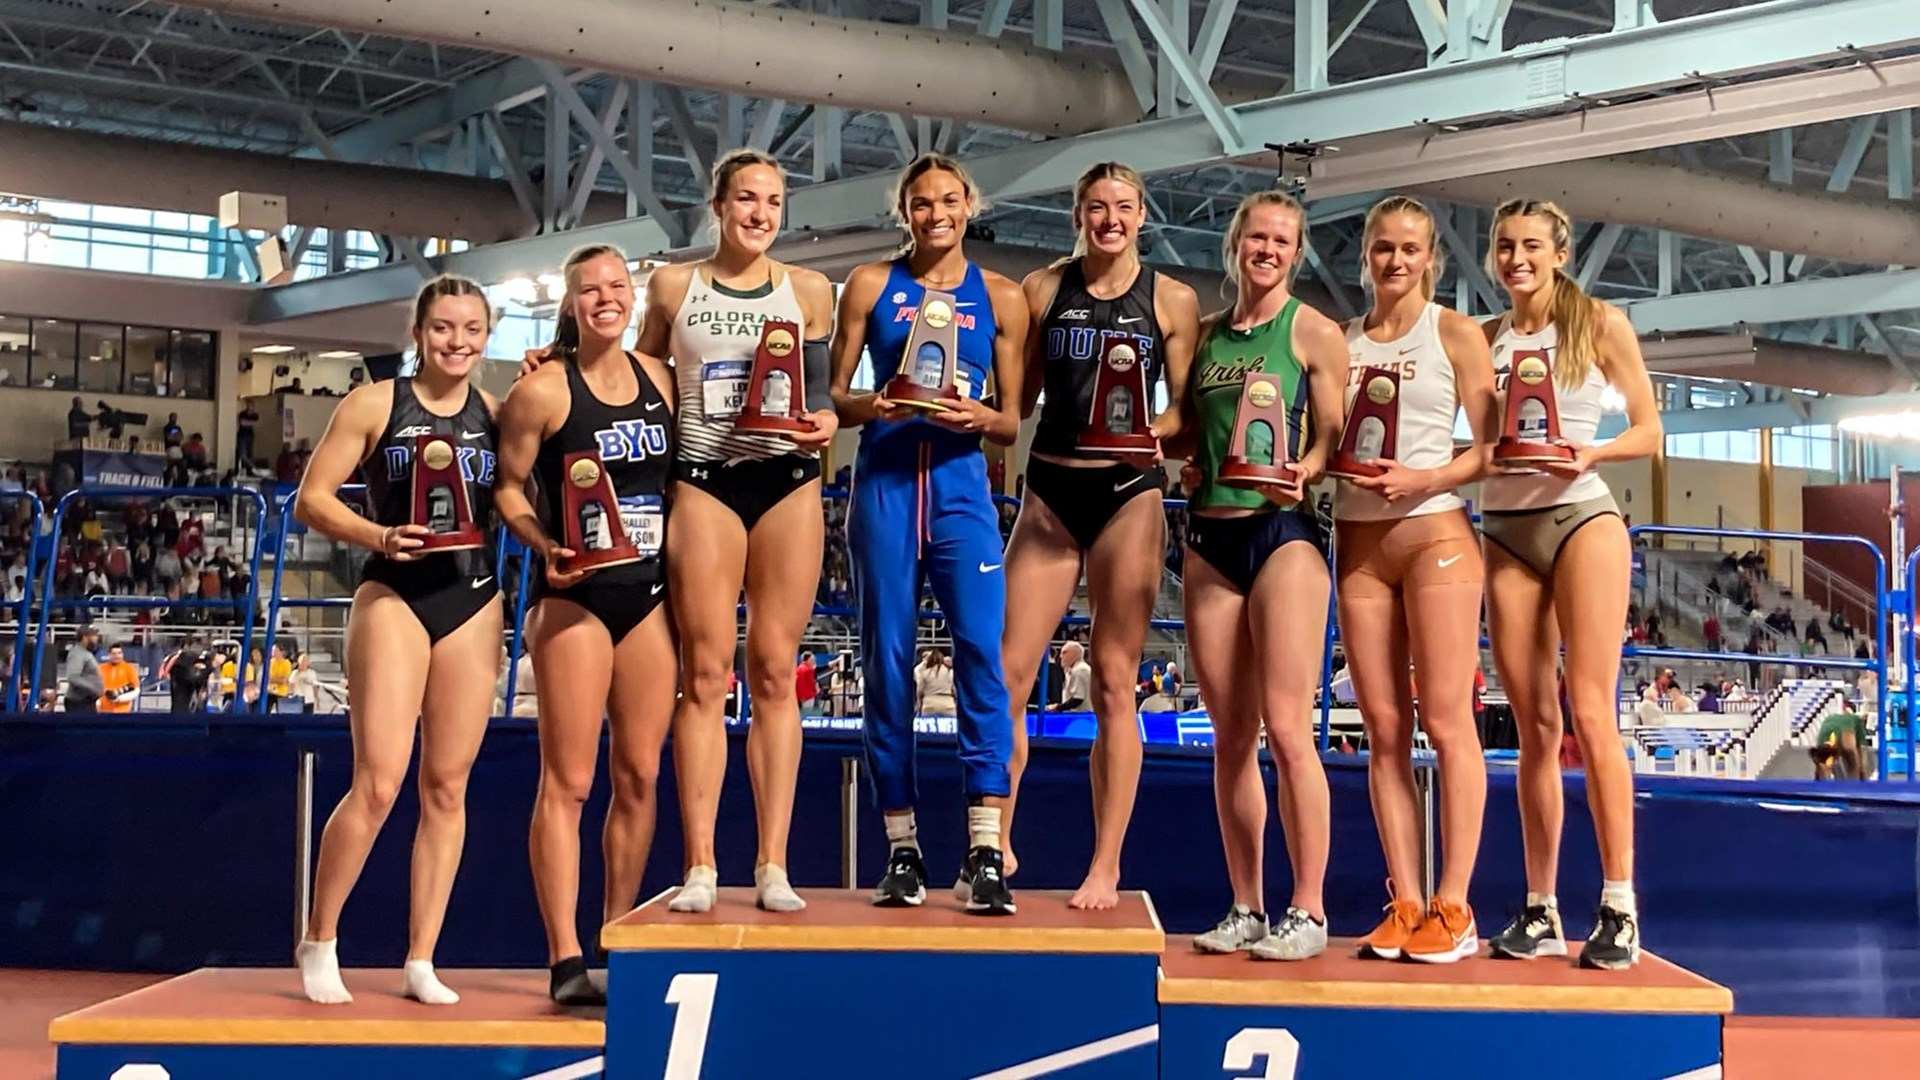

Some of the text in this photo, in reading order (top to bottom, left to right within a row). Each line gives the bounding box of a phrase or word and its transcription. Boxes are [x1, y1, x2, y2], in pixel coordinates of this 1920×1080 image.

[1058, 308, 1090, 320] ACC
[710, 322, 764, 337] STAT
[394, 425, 432, 438] ACC
[594, 418, 668, 463] BYU
[384, 445, 497, 487] DKE
[100, 471, 132, 486] TRACK
[663, 973, 719, 1080] 1
